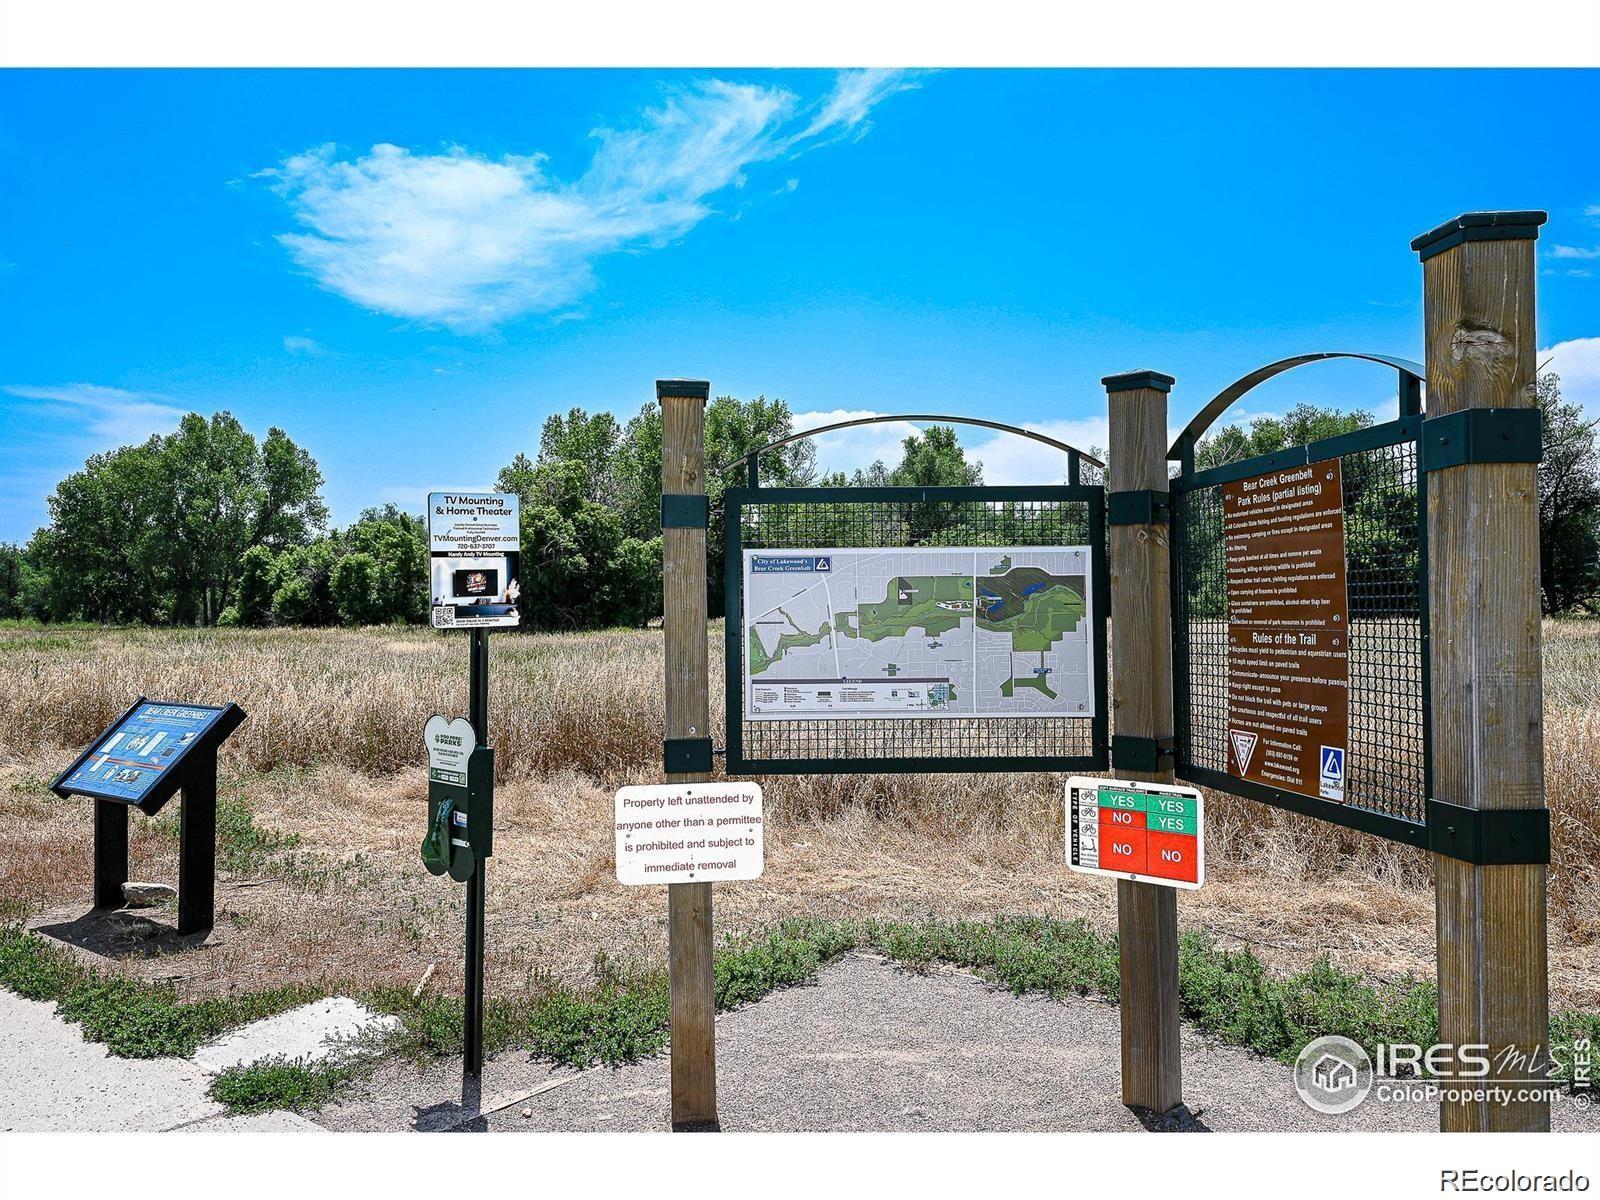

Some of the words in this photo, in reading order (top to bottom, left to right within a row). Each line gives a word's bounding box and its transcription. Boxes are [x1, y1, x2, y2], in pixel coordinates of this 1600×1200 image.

[1243, 481, 1257, 491] Bear
[1259, 476, 1278, 488] Creek
[1279, 468, 1312, 483] Greenbelt
[1237, 497, 1251, 506] Park
[1252, 494, 1270, 503] Rules
[1272, 489, 1295, 502] (partial
[1297, 483, 1322, 497] listing)
[444, 496, 457, 504] TV
[458, 496, 504, 507] Mounting
[476, 507, 512, 515] Theater
[433, 535, 518, 543] TVMountingDenver.com
[1252, 632, 1272, 643] Rules
[1274, 633, 1282, 643] of
[1284, 633, 1296, 644] the
[1299, 633, 1316, 645] Trail
[1307, 650, 1331, 658] equestrian
[1328, 679, 1346, 688] passing
[1320, 782, 1343, 792] Lakewood
[624, 798, 664, 809] Property
[668, 796, 682, 806] left
[685, 794, 739, 805] unattended
[742, 794, 754, 804] by
[1110, 795, 1134, 807] YES
[1159, 800, 1184, 812] YES
[617, 822, 652, 831] anyone
[655, 820, 680, 828] other
[683, 818, 705, 827] than
[716, 816, 762, 826] permittee
[1072, 814, 1078, 824] OF
[1113, 812, 1132, 824] NO
[1159, 817, 1184, 830] YES
[625, 843, 633, 852] is
[636, 840, 684, 853] prohibited
[687, 839, 705, 848] and
[708, 838, 742, 849] subject
[1113, 843, 1132, 855] NO
[1162, 850, 1181, 862] NO
[644, 862, 695, 872] immediate
[698, 860, 736, 870] removal
